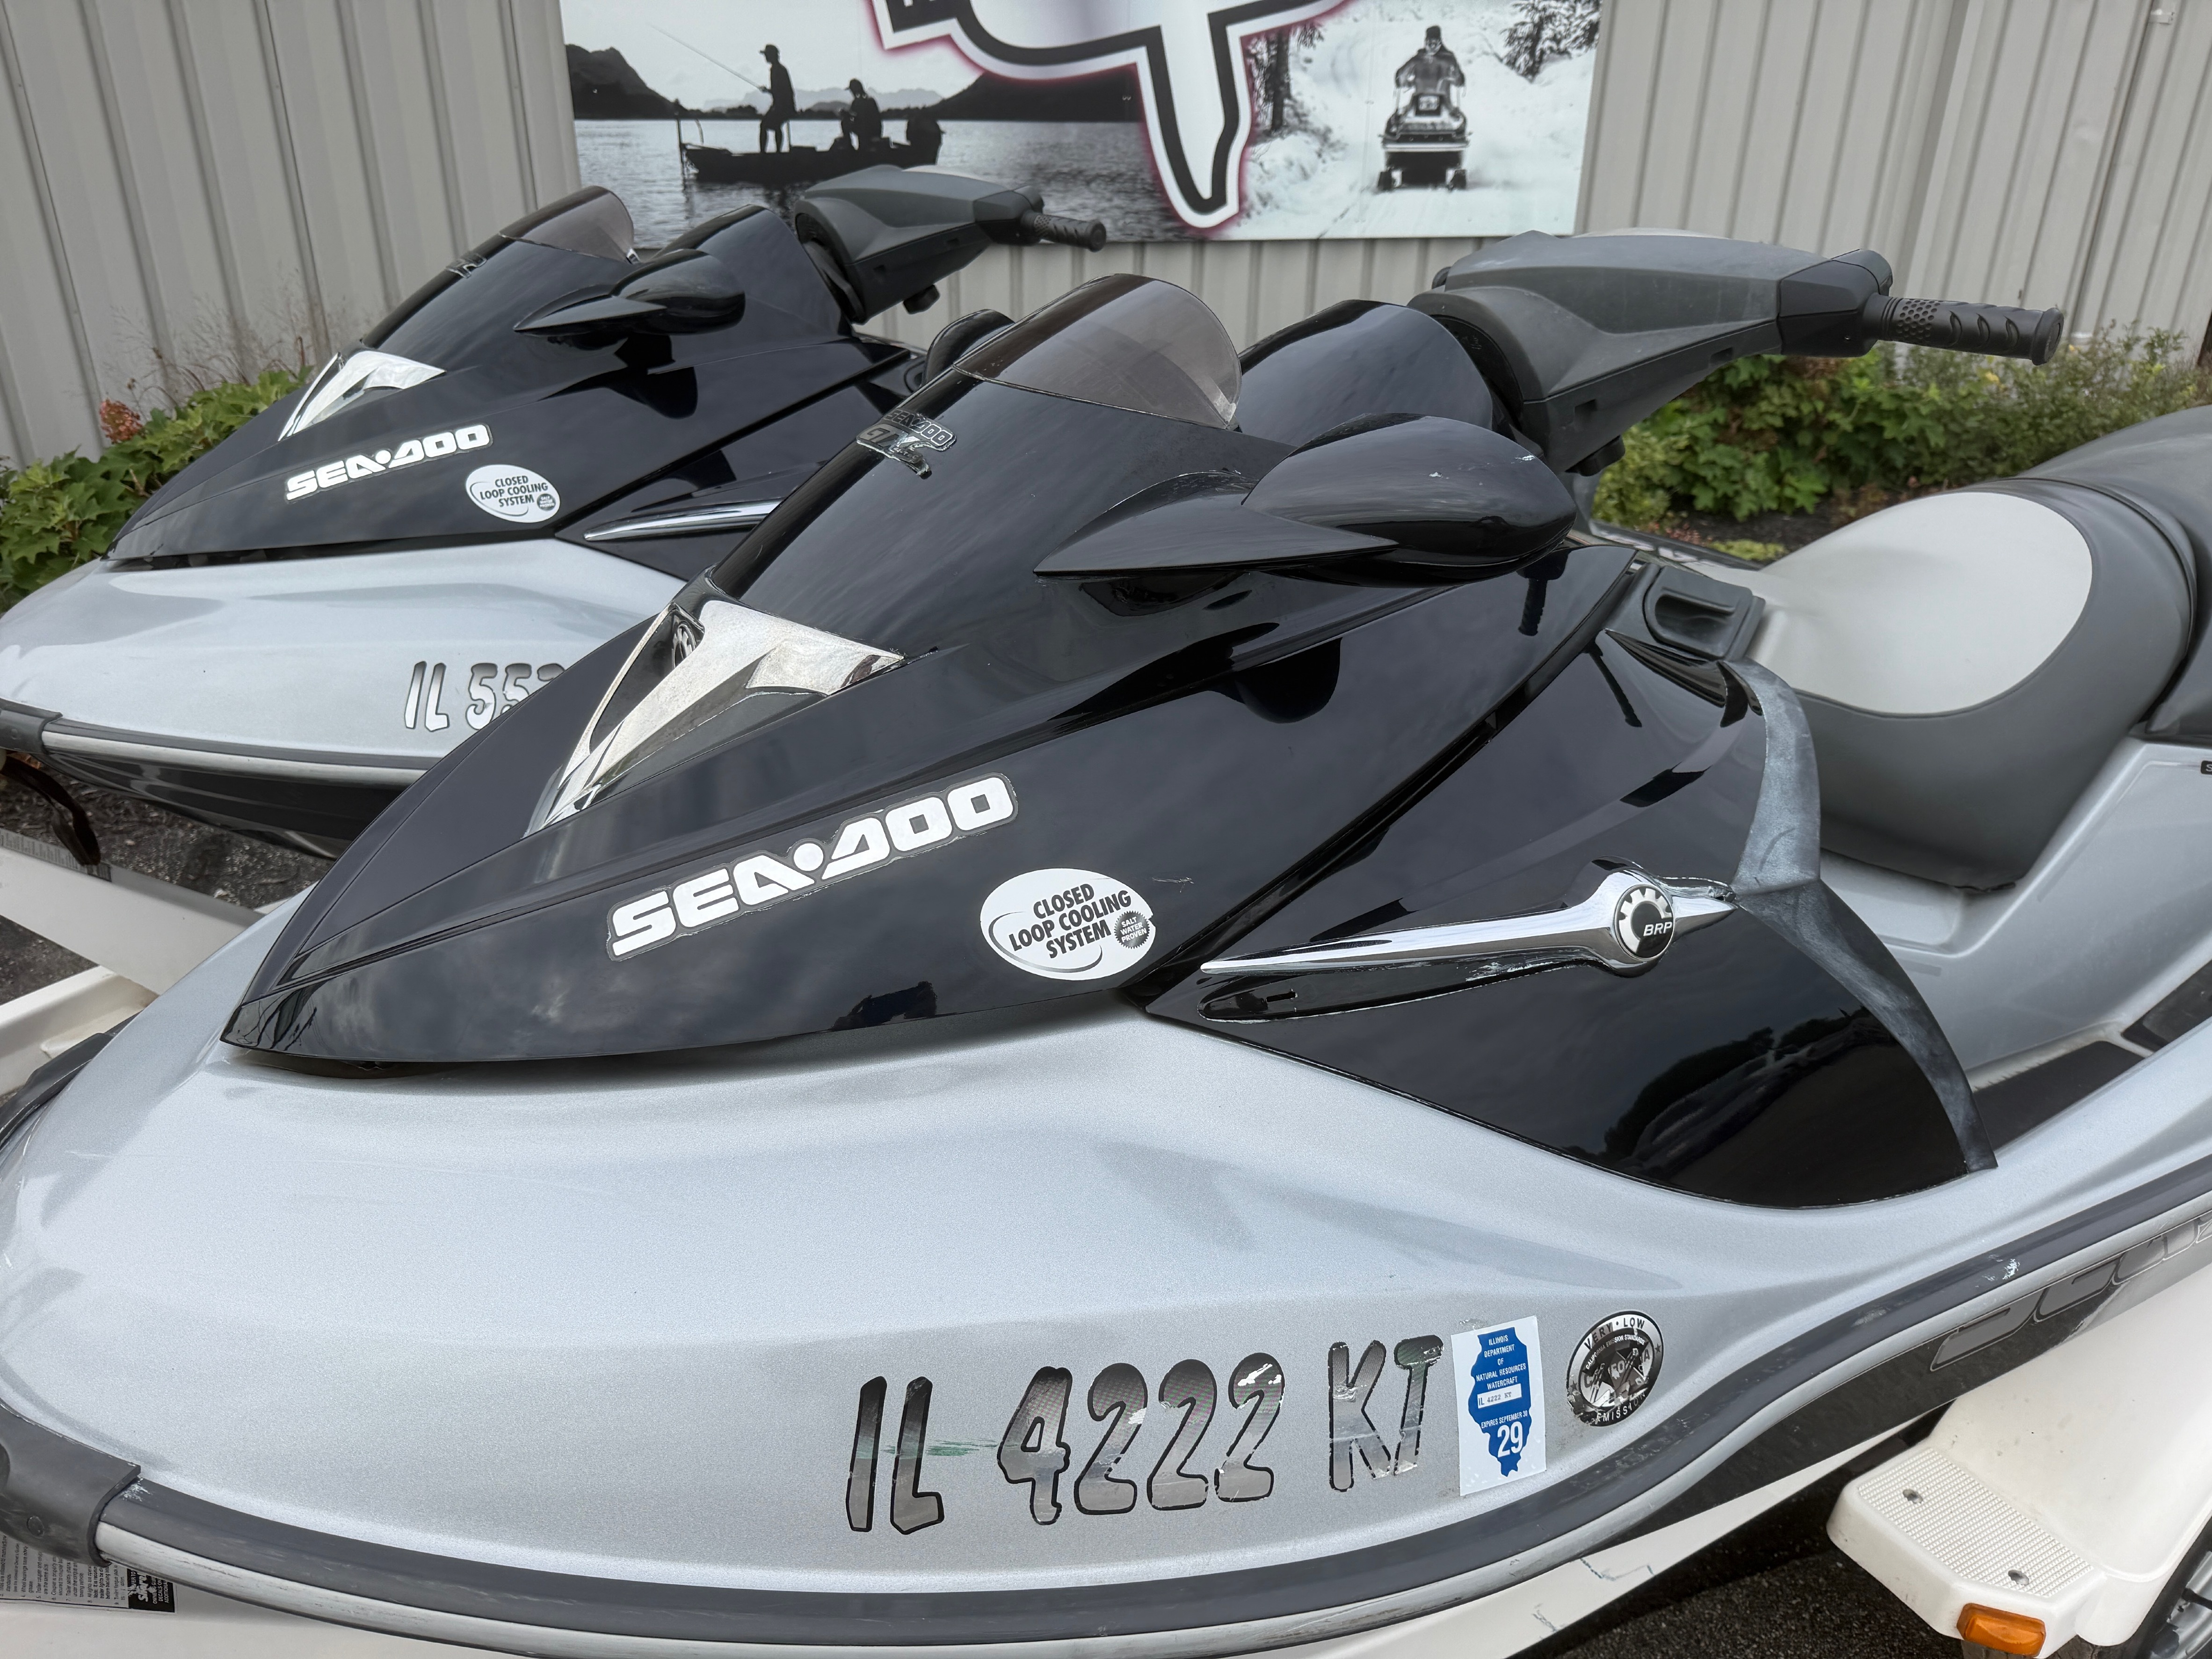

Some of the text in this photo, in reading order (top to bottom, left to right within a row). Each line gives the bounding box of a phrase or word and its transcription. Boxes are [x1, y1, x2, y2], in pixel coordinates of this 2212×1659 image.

[495, 475, 529, 488] CLOSED
[480, 482, 548, 500] LOOP COOLING
[499, 495, 535, 507] SYSTEM
[404, 661, 566, 732] IL 55
[1033, 883, 1094, 919] CLOSED
[1009, 890, 1131, 951] LOOP COOLING
[1120, 923, 1143, 935] WATER
[1121, 917, 1137, 927] SALT
[1643, 922, 1672, 936] BRP
[1046, 920, 1111, 959] SYSTEM
[1121, 928, 1147, 943] PROVEN
[1488, 1334, 1509, 1346] ILLINOIS
[1584, 1317, 1645, 1350] VERY LOW
[1484, 1344, 1515, 1358] DEPARTMENT
[1586, 1334, 1645, 1370] CALIFORNIA EMISSION STANDARDS
[1476, 1363, 1526, 1382] NATURAL RESOURCES
[1487, 1376, 1518, 1390] WATERCRAFT
[1479, 1397, 1485, 1406] IL
[1487, 1395, 1501, 1403] 4222
[1481, 1418, 1499, 1429] EXPIRES
[1499, 1412, 1523, 1425] SEPTEMBER
[846, 1334, 1444, 1535] IL 4222 KT
[1497, 1421, 1523, 1458] 29
